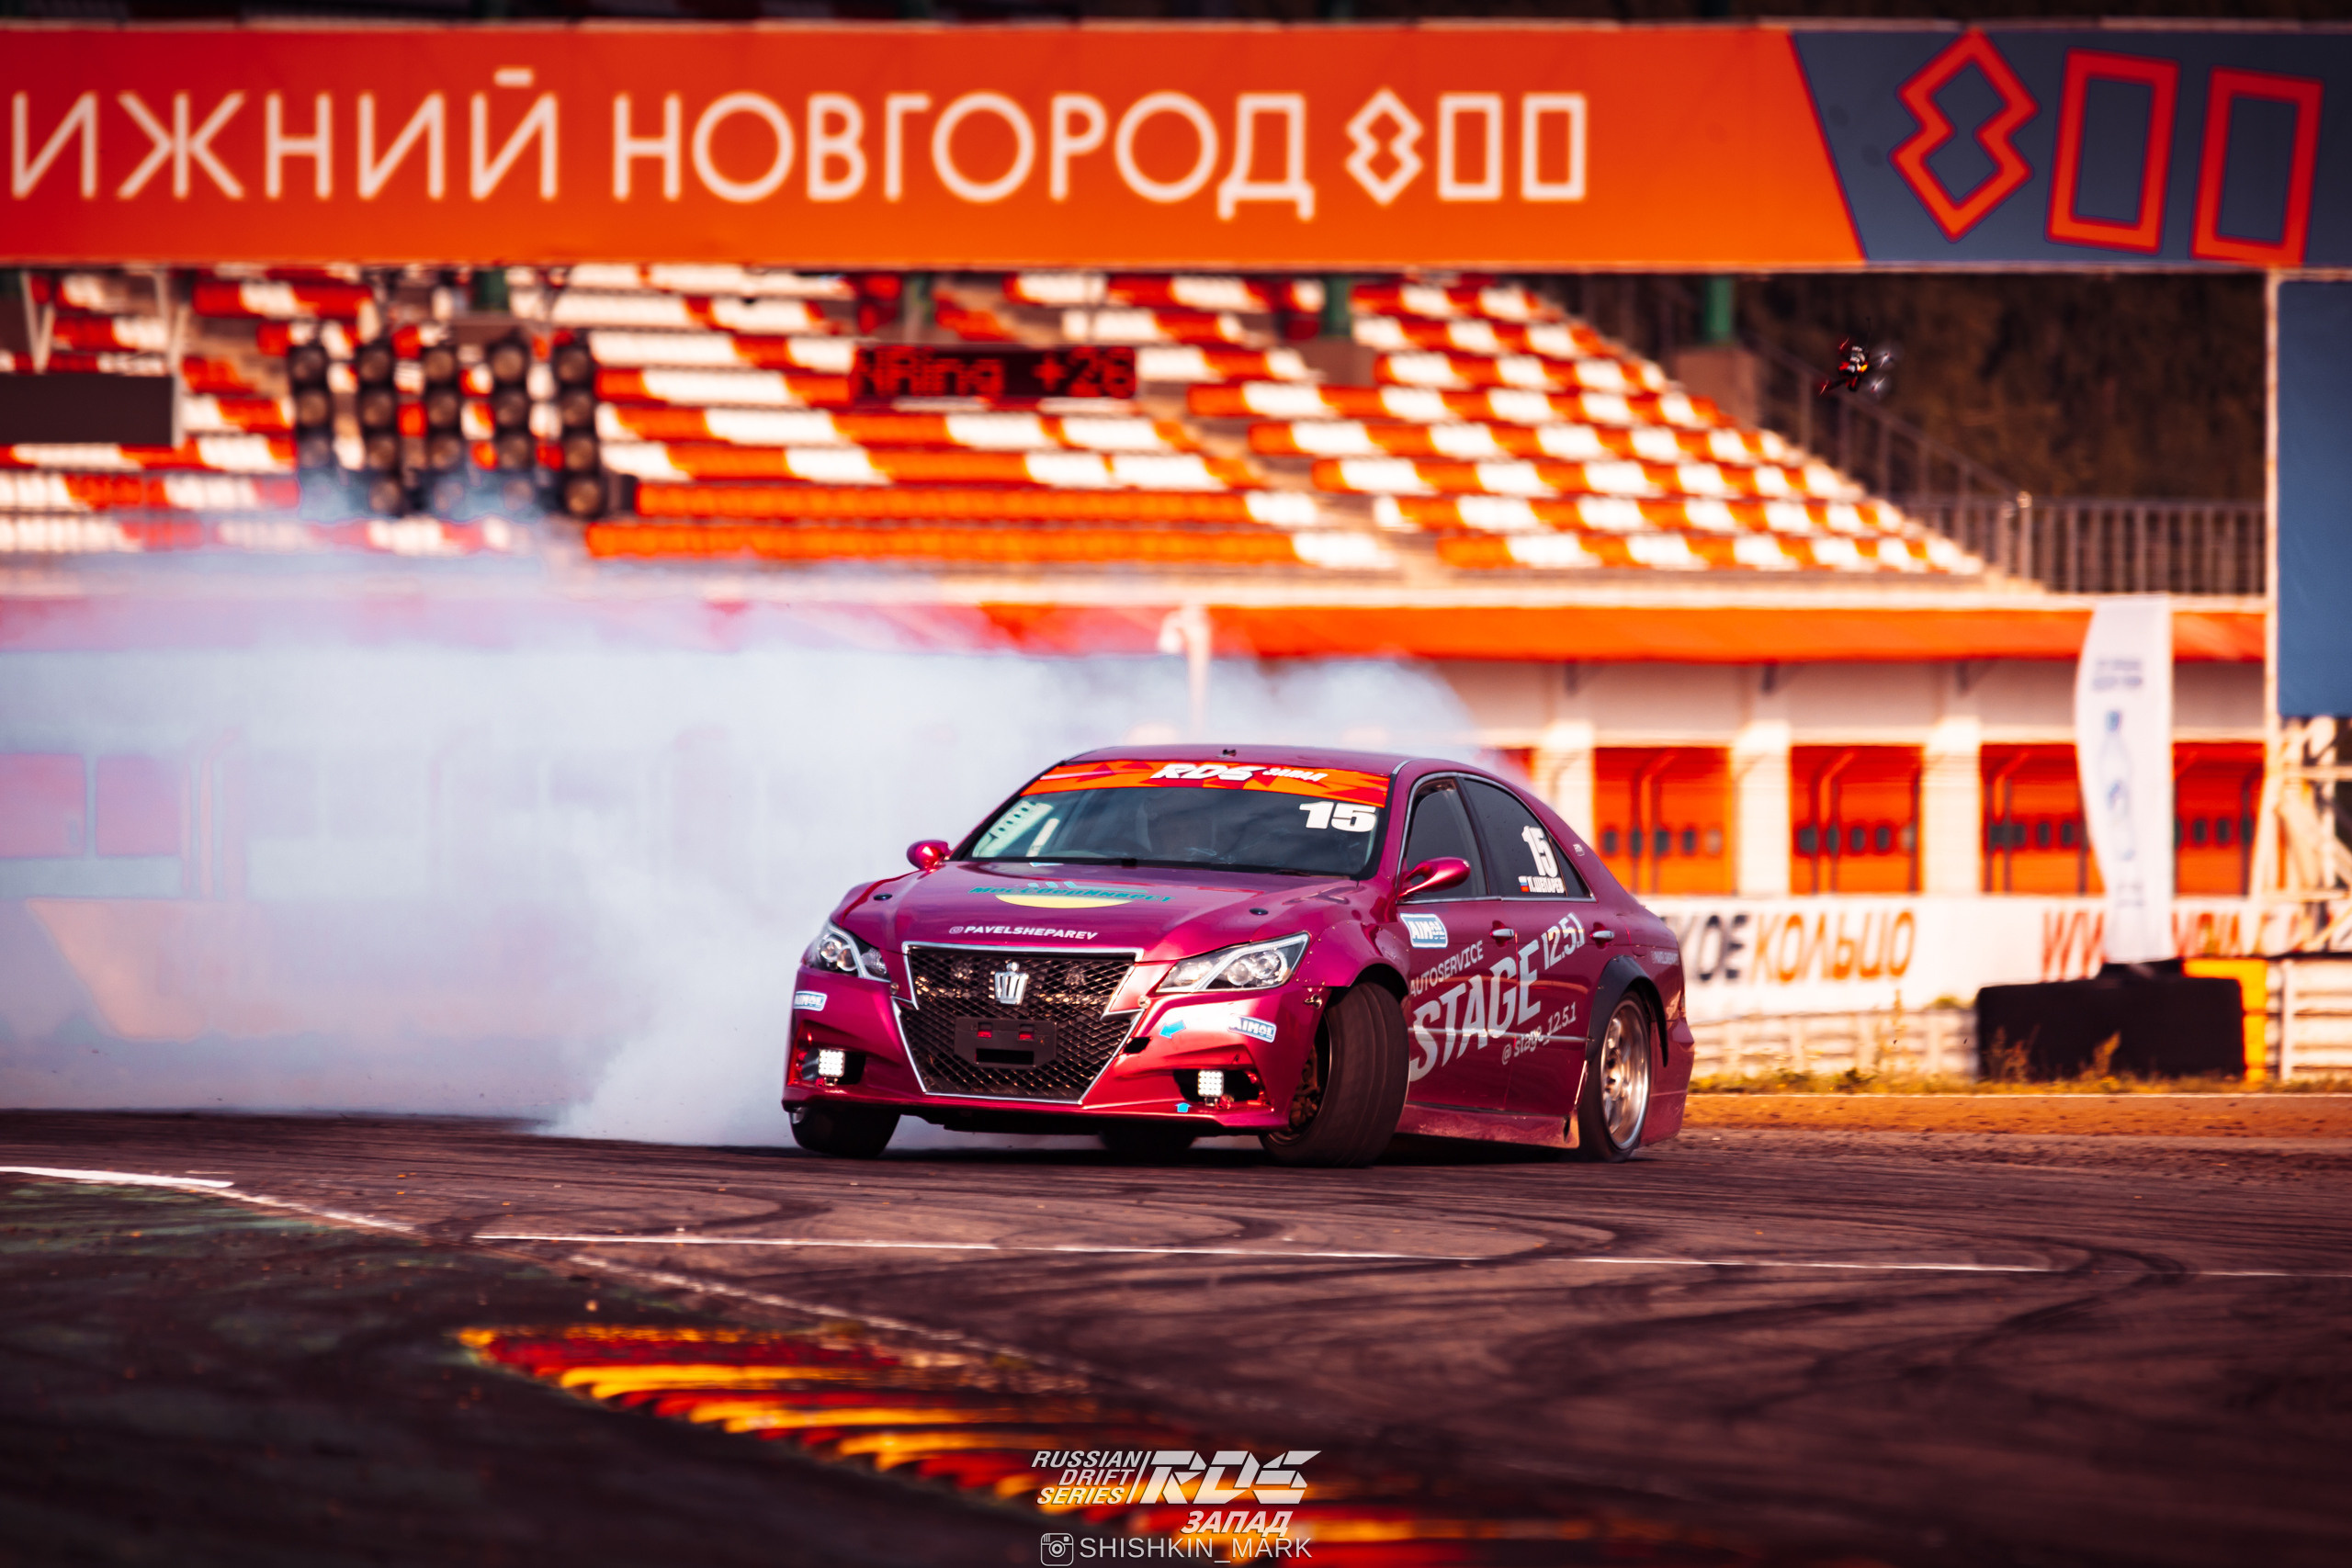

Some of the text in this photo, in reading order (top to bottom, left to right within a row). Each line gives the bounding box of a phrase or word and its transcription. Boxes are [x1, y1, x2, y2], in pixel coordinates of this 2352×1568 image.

[613, 91, 1316, 220] НОВГОРОД
[1149, 762, 1264, 782] RDS
[1299, 801, 1377, 832] 15
[1521, 826, 1558, 878] 15
[964, 925, 1098, 941] PAVELSHEPAREV
[1748, 909, 1917, 985] КОЛЬЦО
[1409, 940, 1484, 998] AUTOSERVICE
[1409, 911, 1586, 1082] STAGE 12.5.1
